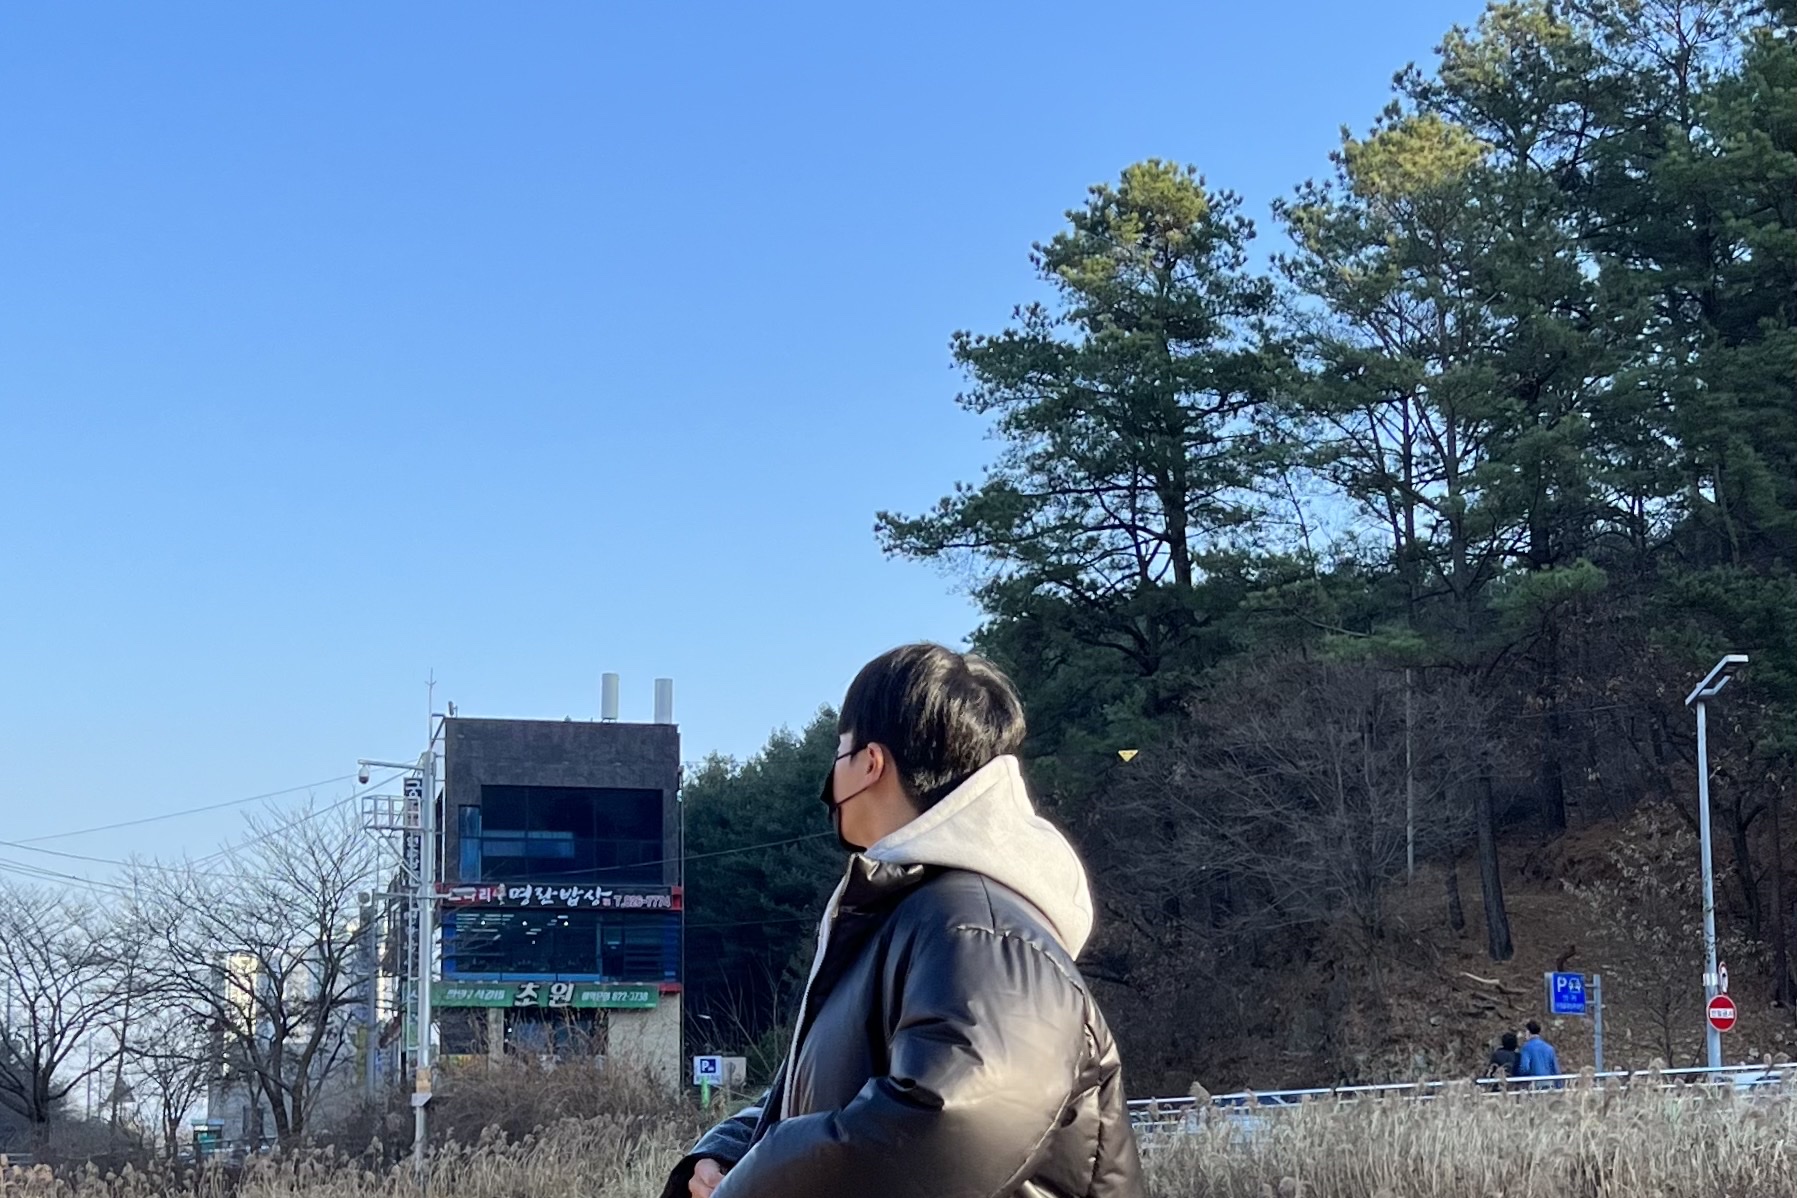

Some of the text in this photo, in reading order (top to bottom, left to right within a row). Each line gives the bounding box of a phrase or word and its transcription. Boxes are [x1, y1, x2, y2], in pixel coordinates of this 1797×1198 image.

[1557, 976, 1568, 993] P
[513, 982, 575, 1007] 초원
[701, 1060, 710, 1072] P
